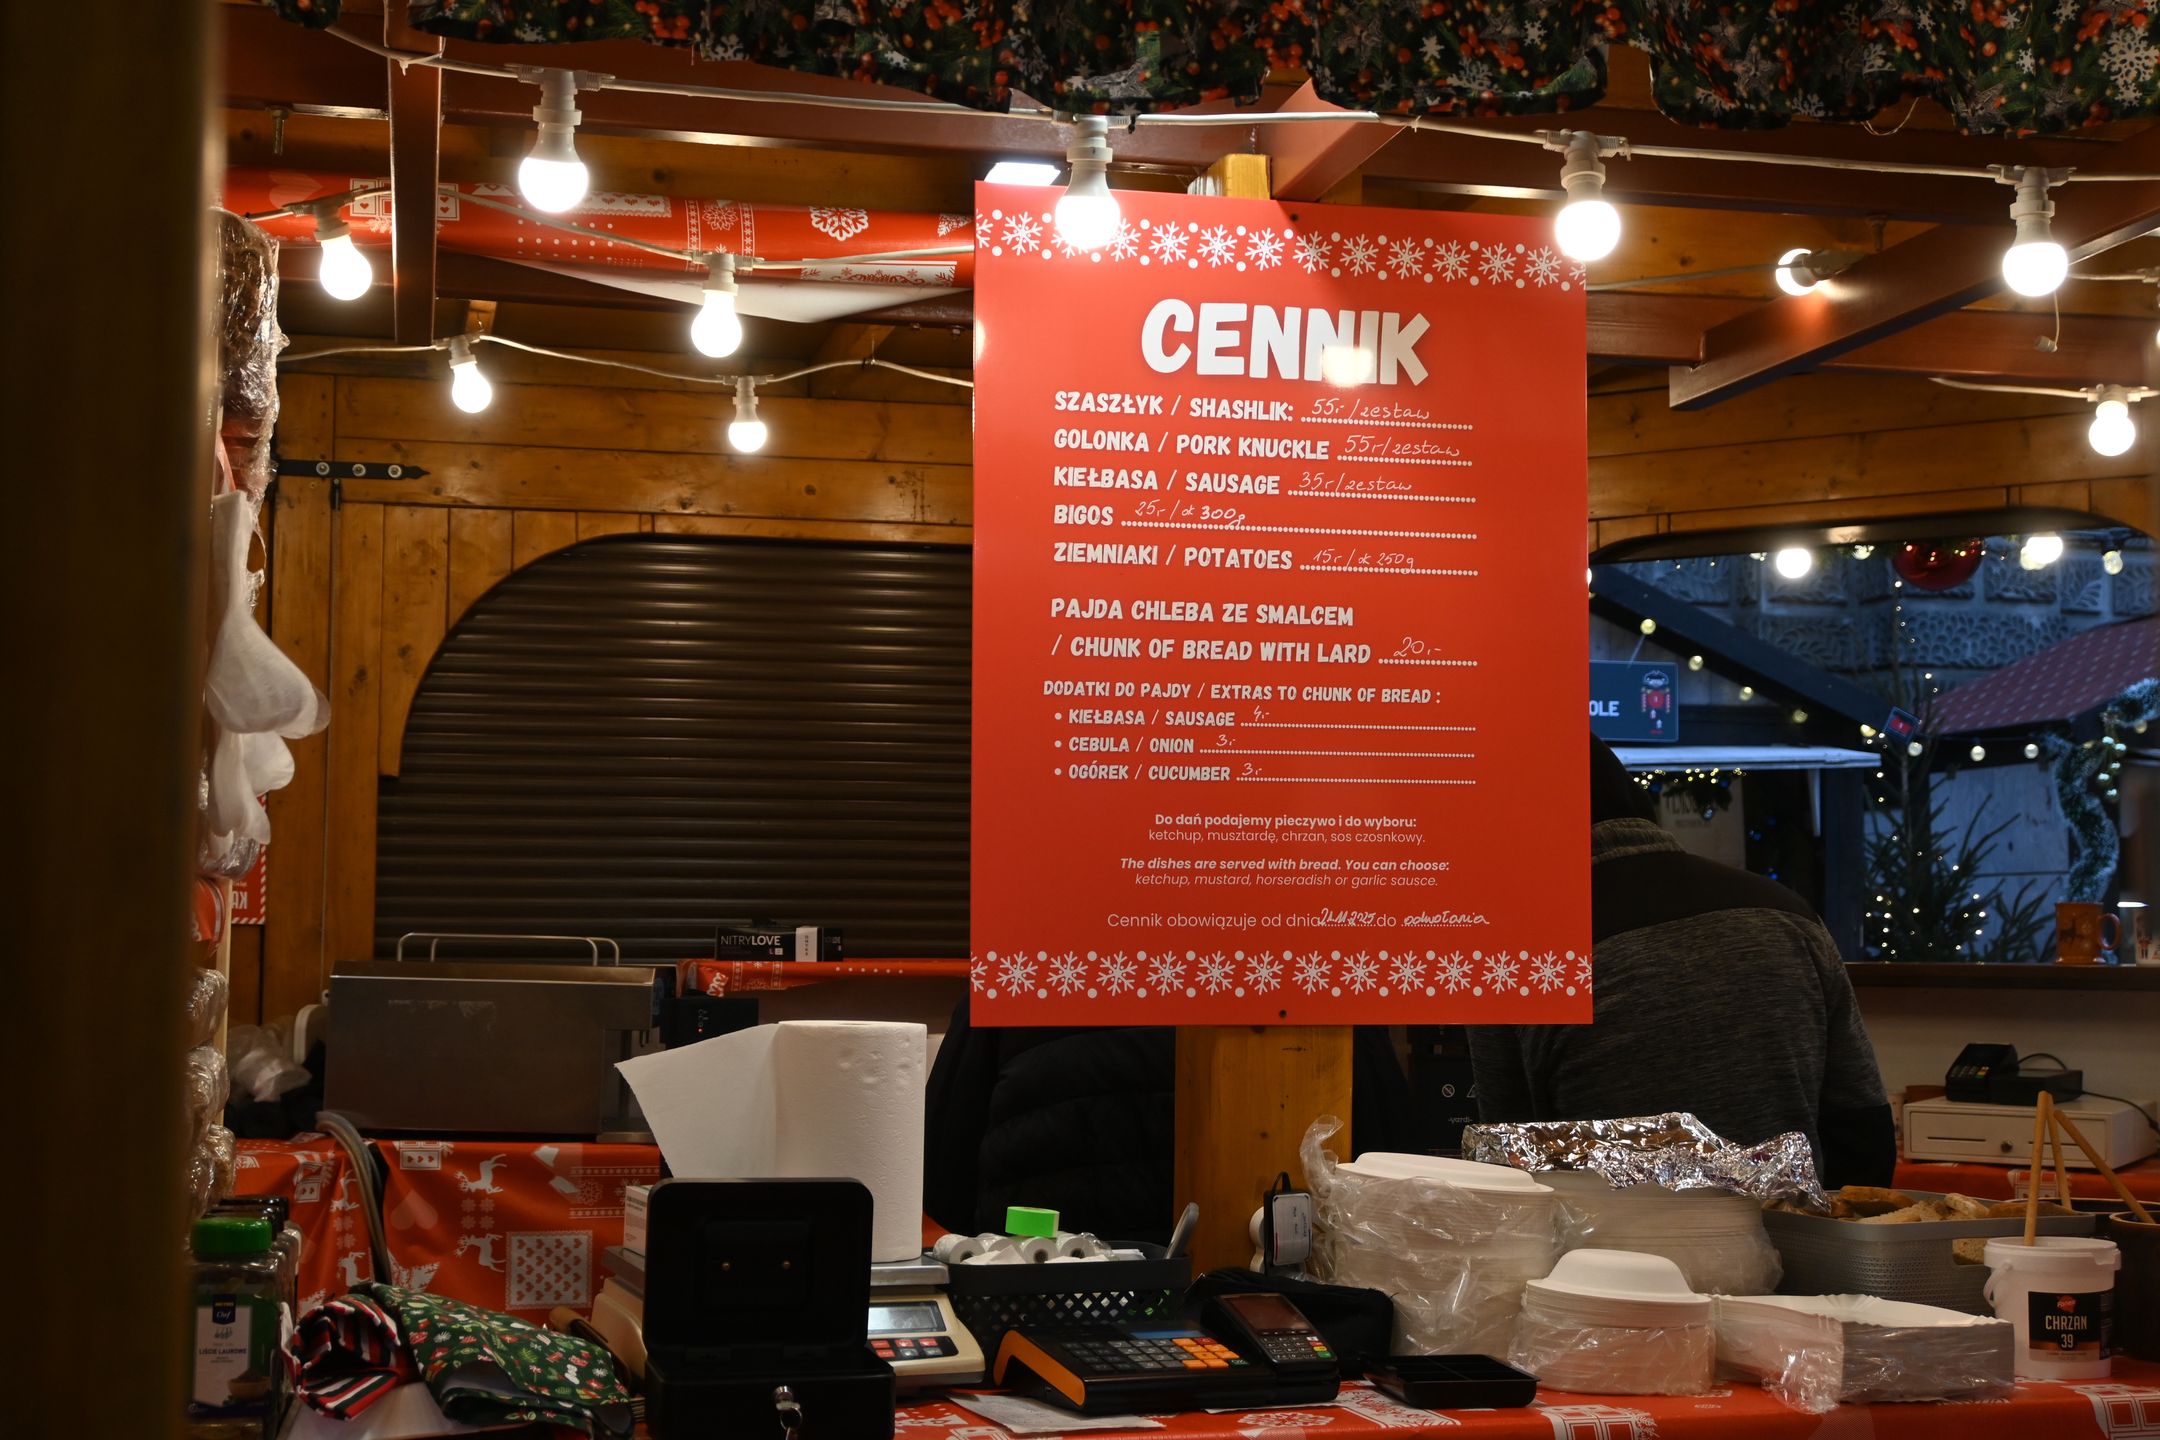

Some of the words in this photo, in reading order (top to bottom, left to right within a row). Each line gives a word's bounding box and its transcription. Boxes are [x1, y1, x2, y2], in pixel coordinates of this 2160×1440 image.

[1141, 299, 1431, 386] CENNIK
[1055, 391, 1163, 415] SZASZŁYK
[1190, 398, 1293, 421] SHASHLIK:
[1054, 429, 1149, 452] GOLONKA
[1177, 435, 1231, 455] PORK
[1239, 437, 1329, 459] KNUCKLE
[1054, 466, 1158, 490] KIEŁBASA
[1186, 472, 1280, 494] SAUSAGE
[1054, 505, 1113, 525] BIGOS
[1054, 542, 1158, 565] ZIEMNIAKI
[1185, 547, 1292, 569] POTATOES
[1051, 598, 1123, 619] PAJDA
[1132, 601, 1213, 622] CHLEBA
[1222, 603, 1248, 622] ZE
[1256, 604, 1353, 626] SMALCEM
[1071, 637, 1141, 657] CHUNK
[1149, 639, 1174, 658] OF
[1183, 640, 1252, 660] BREAD
[1260, 642, 1309, 662] WITH
[1318, 643, 1370, 663] LARD
[1044, 681, 1110, 696] DODATKI
[1115, 682, 1135, 696] DO
[1141, 683, 1191, 697] PAJDY
[1211, 685, 1272, 699] EXTRAS
[1278, 686, 1297, 700] TO
[1303, 687, 1352, 701] CHUNK
[1358, 688, 1376, 702] OF
[1382, 689, 1431, 703] BREAD
[1069, 709, 1145, 724] KIEŁBASA
[1166, 711, 1235, 726] SAUSAGE
[1069, 737, 1129, 752] CEBULA
[1150, 738, 1194, 753] ONION
[1069, 764, 1128, 779] OGÓREK
[1149, 766, 1230, 780] CUCUMBER
[1156, 814, 1172, 824] Do
[1176, 813, 1201, 824] dań
[1205, 814, 1272, 829] podajemy
[1275, 815, 1336, 829] pieczywo
[1339, 815, 1342, 826] i
[1345, 816, 1361, 826] do
[1364, 816, 1416, 830] wyboru:
[1149, 829, 1203, 843] ketchup,
[1208, 830, 1278, 843] musztardę,
[1282, 831, 1327, 843] chrzan,
[1331, 833, 1351, 841] sos
[1355, 832, 1425, 845] czosnkowy.
[1121, 858, 1144, 868] The
[1148, 857, 1191, 868] dishes
[1195, 861, 1216, 869] are
[1220, 858, 1263, 870] served
[1267, 858, 1294, 869] with
[1299, 859, 1341, 869] bread.
[1346, 860, 1369, 870] You
[1373, 862, 1396, 870] can
[1400, 860, 1449, 870] choose:
[1136, 874, 1190, 887] ketchup,
[1195, 874, 1251, 886] mustard,
[1256, 874, 1331, 885] horseradish
[1335, 877, 1348, 885] or
[1352, 875, 1387, 888] garlic
[1391, 877, 1437, 886] sausce.
[1108, 913, 1162, 926] Cennik
[1167, 913, 1256, 930] obowiązuje
[1262, 914, 1281, 926] od
[1286, 914, 1320, 926] dnia
[1377, 914, 1396, 927] do
[720, 935, 781, 946] NITRYLOVE
[2045, 1315, 2088, 1330] CHRZAN
[2060, 1333, 2074, 1348] 39
